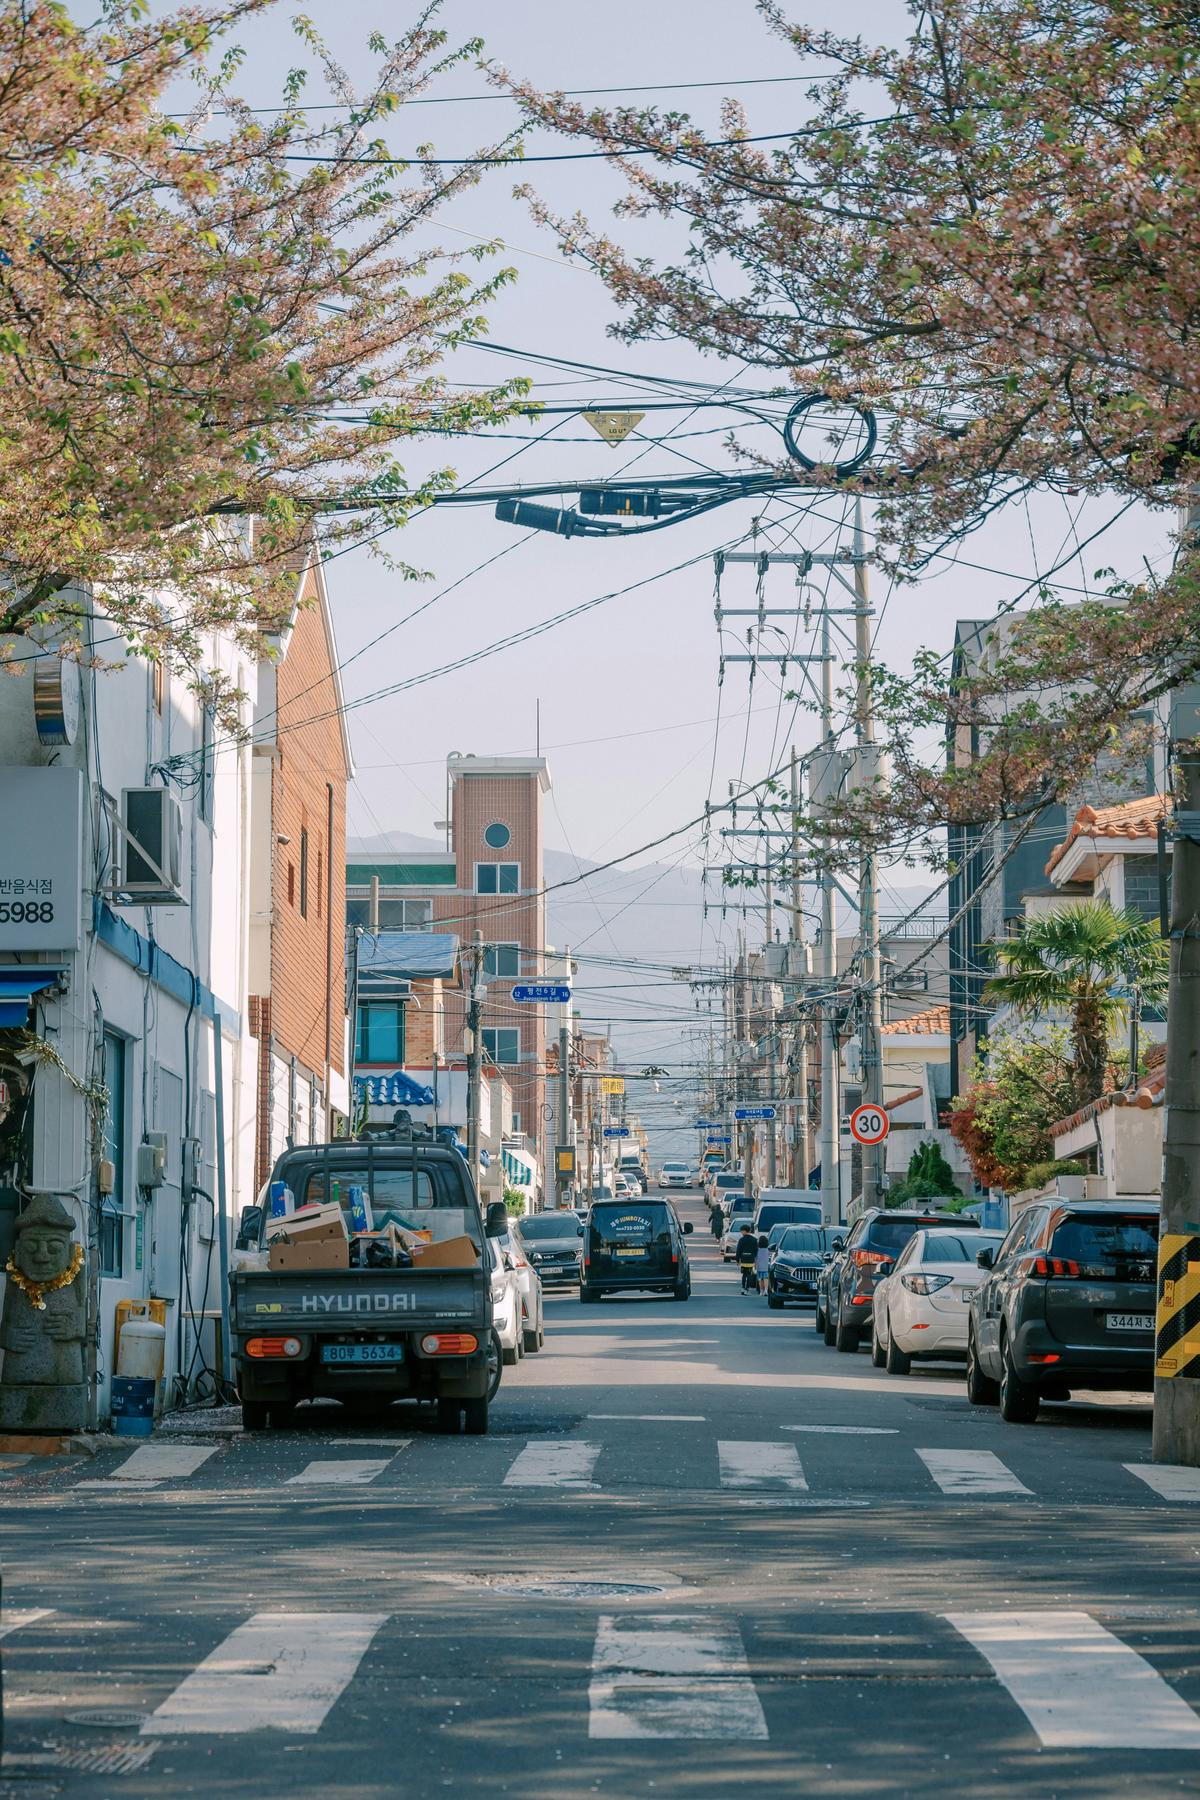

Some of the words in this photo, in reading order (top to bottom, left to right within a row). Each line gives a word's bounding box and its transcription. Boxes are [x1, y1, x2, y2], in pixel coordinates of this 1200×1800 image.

[0, 901, 54, 924] 5988
[859, 1114, 881, 1133] 30
[301, 1293, 417, 1312] HYUNDAI
[361, 1346, 396, 1360] 5634
